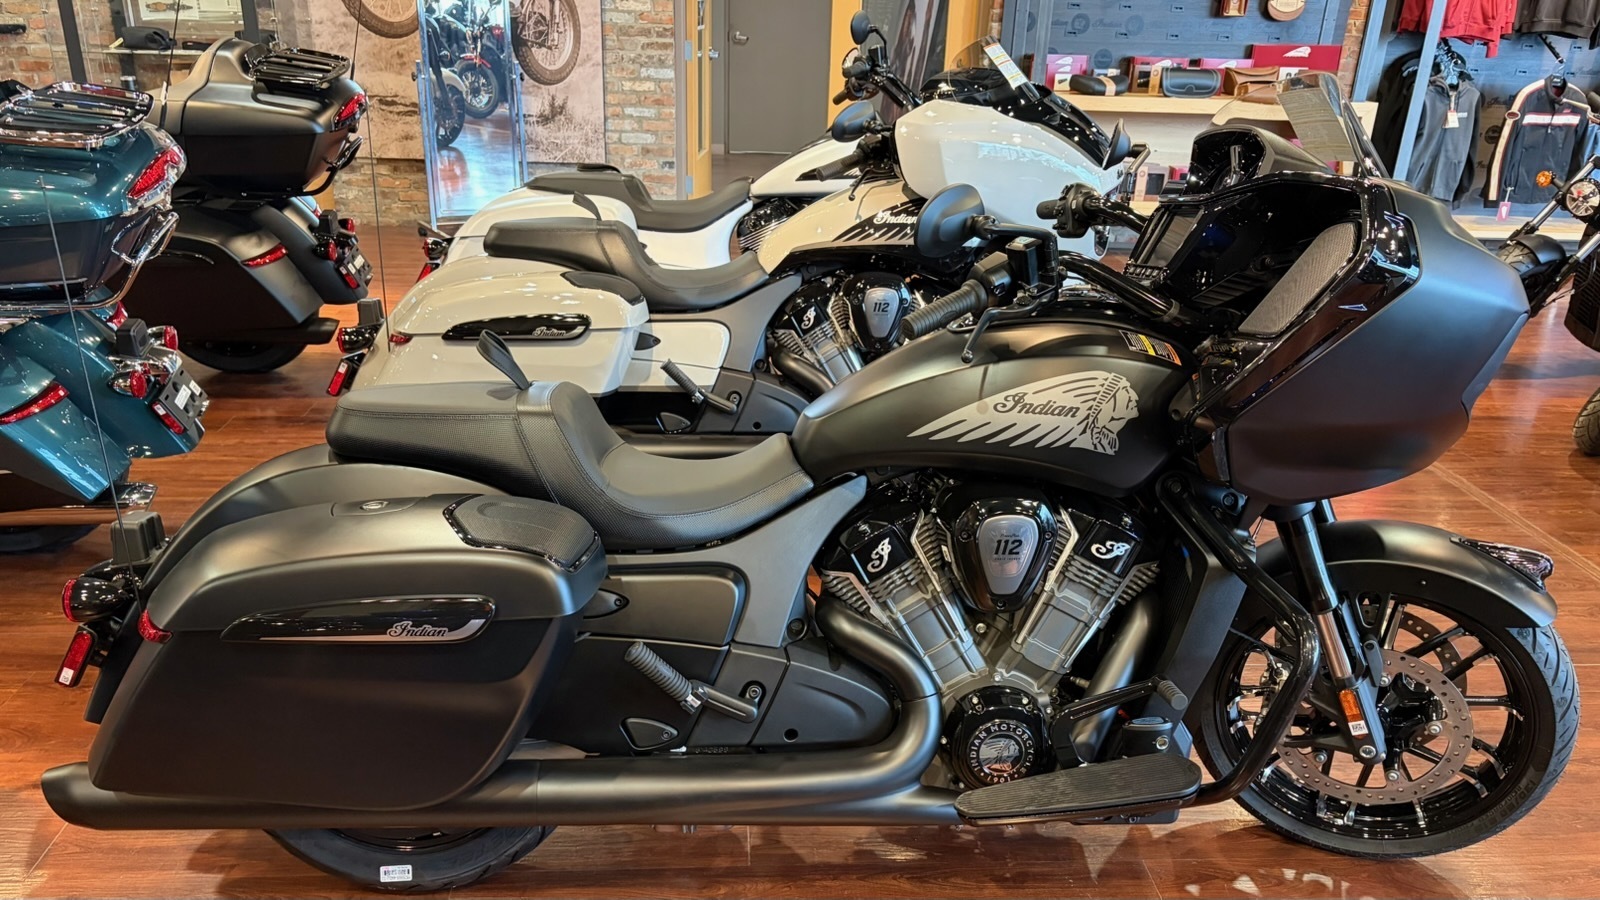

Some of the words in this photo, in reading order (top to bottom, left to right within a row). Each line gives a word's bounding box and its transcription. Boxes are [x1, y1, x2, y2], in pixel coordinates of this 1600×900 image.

[873, 210, 918, 225] Indian
[872, 302, 890, 313] 112
[532, 326, 566, 337] Indian
[992, 391, 1081, 418] Indian
[994, 539, 1023, 556] 112
[387, 620, 448, 638] Indian
[970, 731, 987, 771] INDIAN
[990, 724, 1034, 773] MOTORCYCLE
